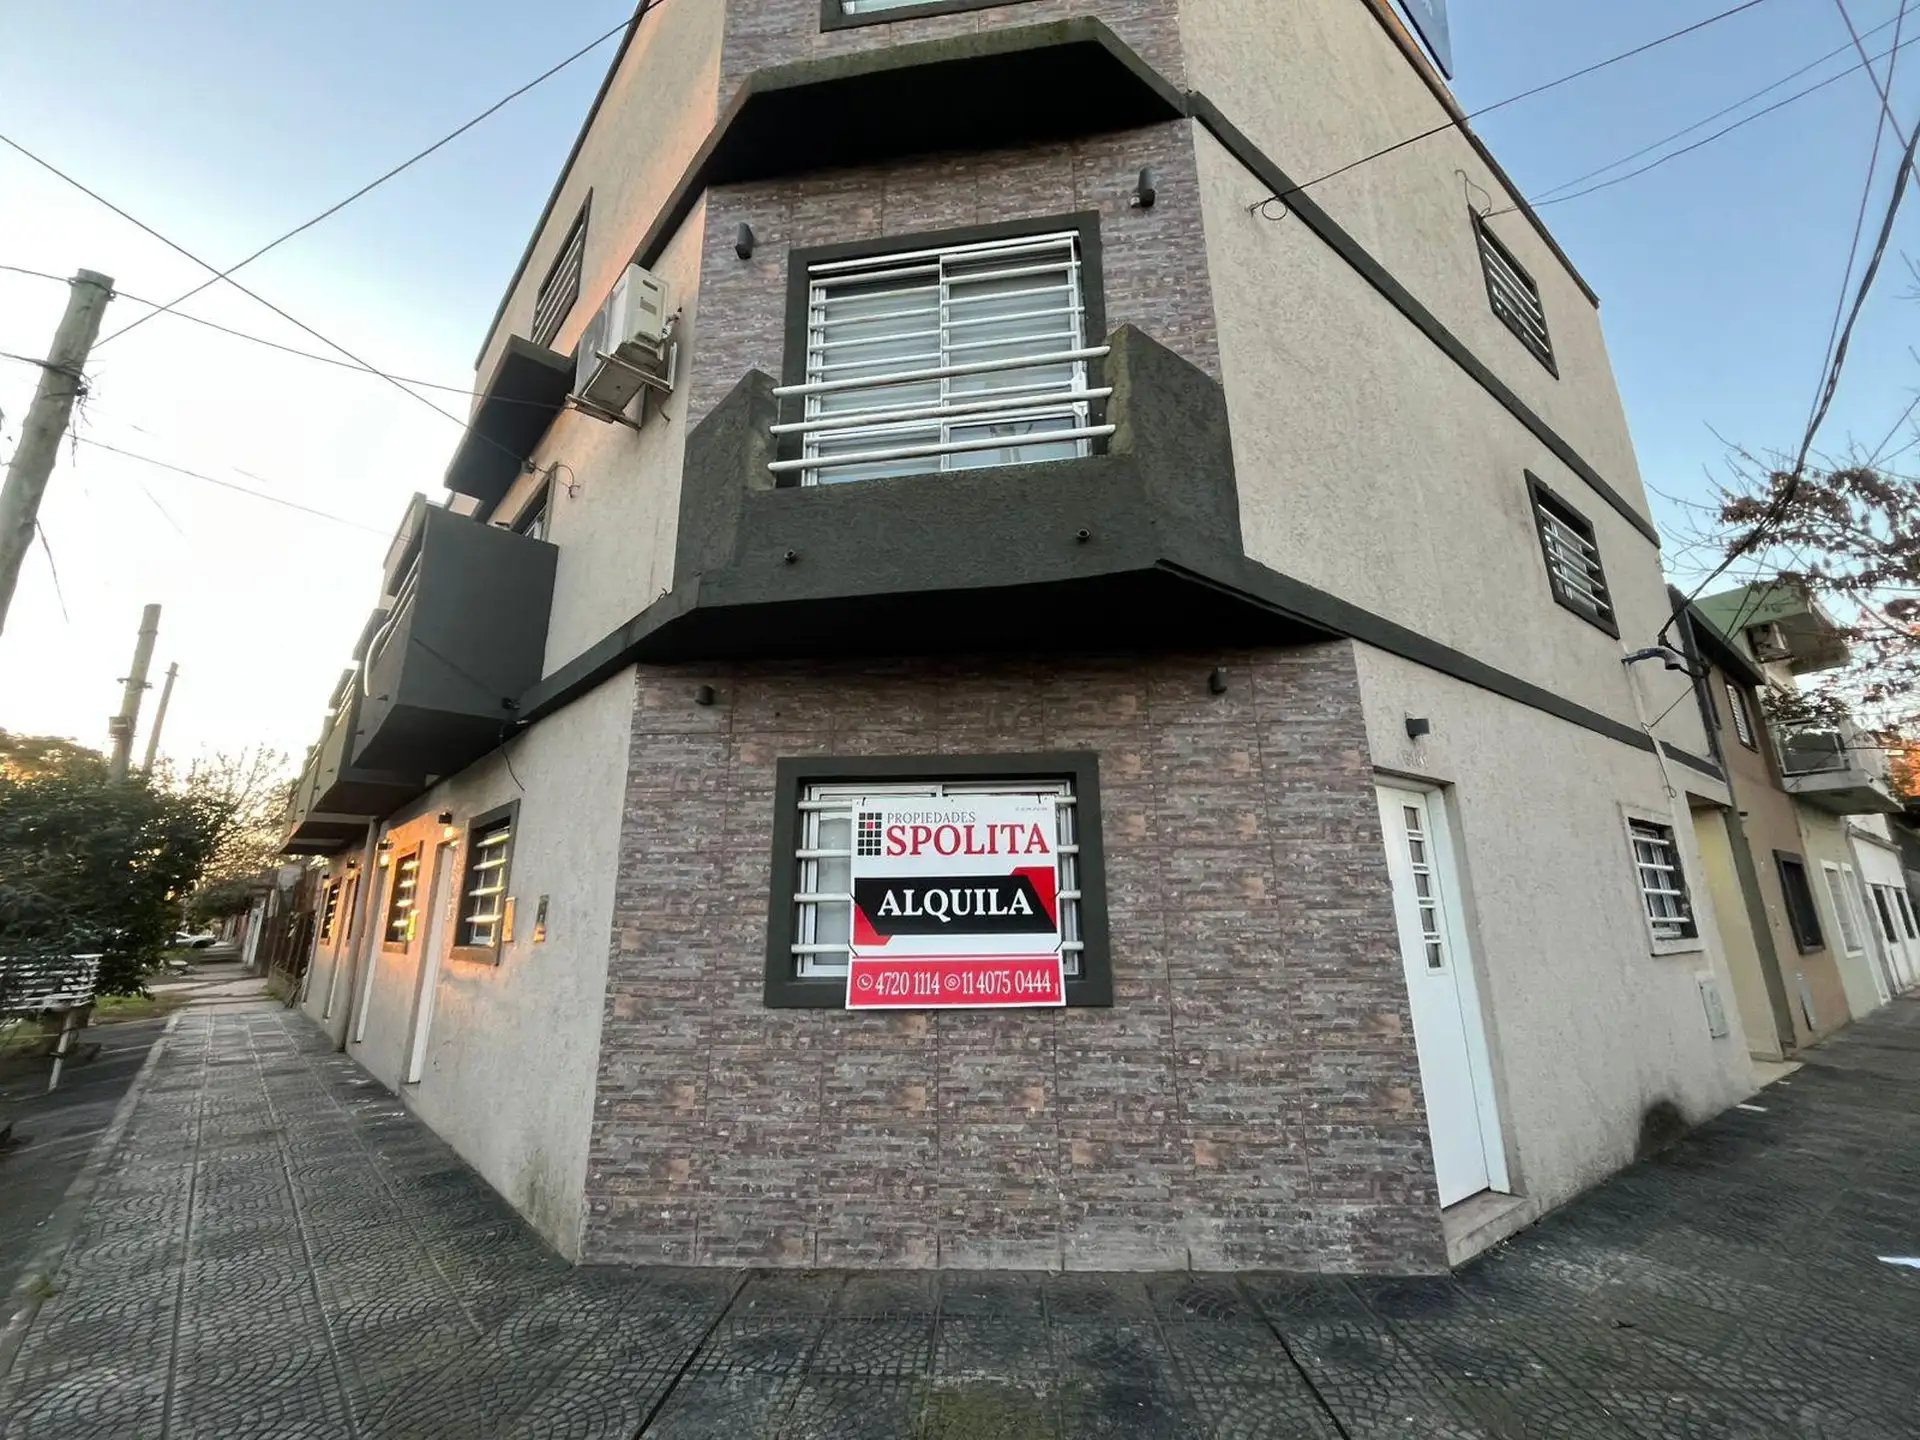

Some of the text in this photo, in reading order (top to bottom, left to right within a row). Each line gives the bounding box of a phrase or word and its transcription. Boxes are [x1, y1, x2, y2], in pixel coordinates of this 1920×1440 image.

[887, 811, 976, 824] PROPIEDADES
[886, 823, 1050, 856] SPOLITA
[877, 888, 1033, 923] ALQUILA
[874, 971, 910, 996] 4720
[913, 971, 940, 995] 1114
[1015, 969, 1051, 993] 0444
